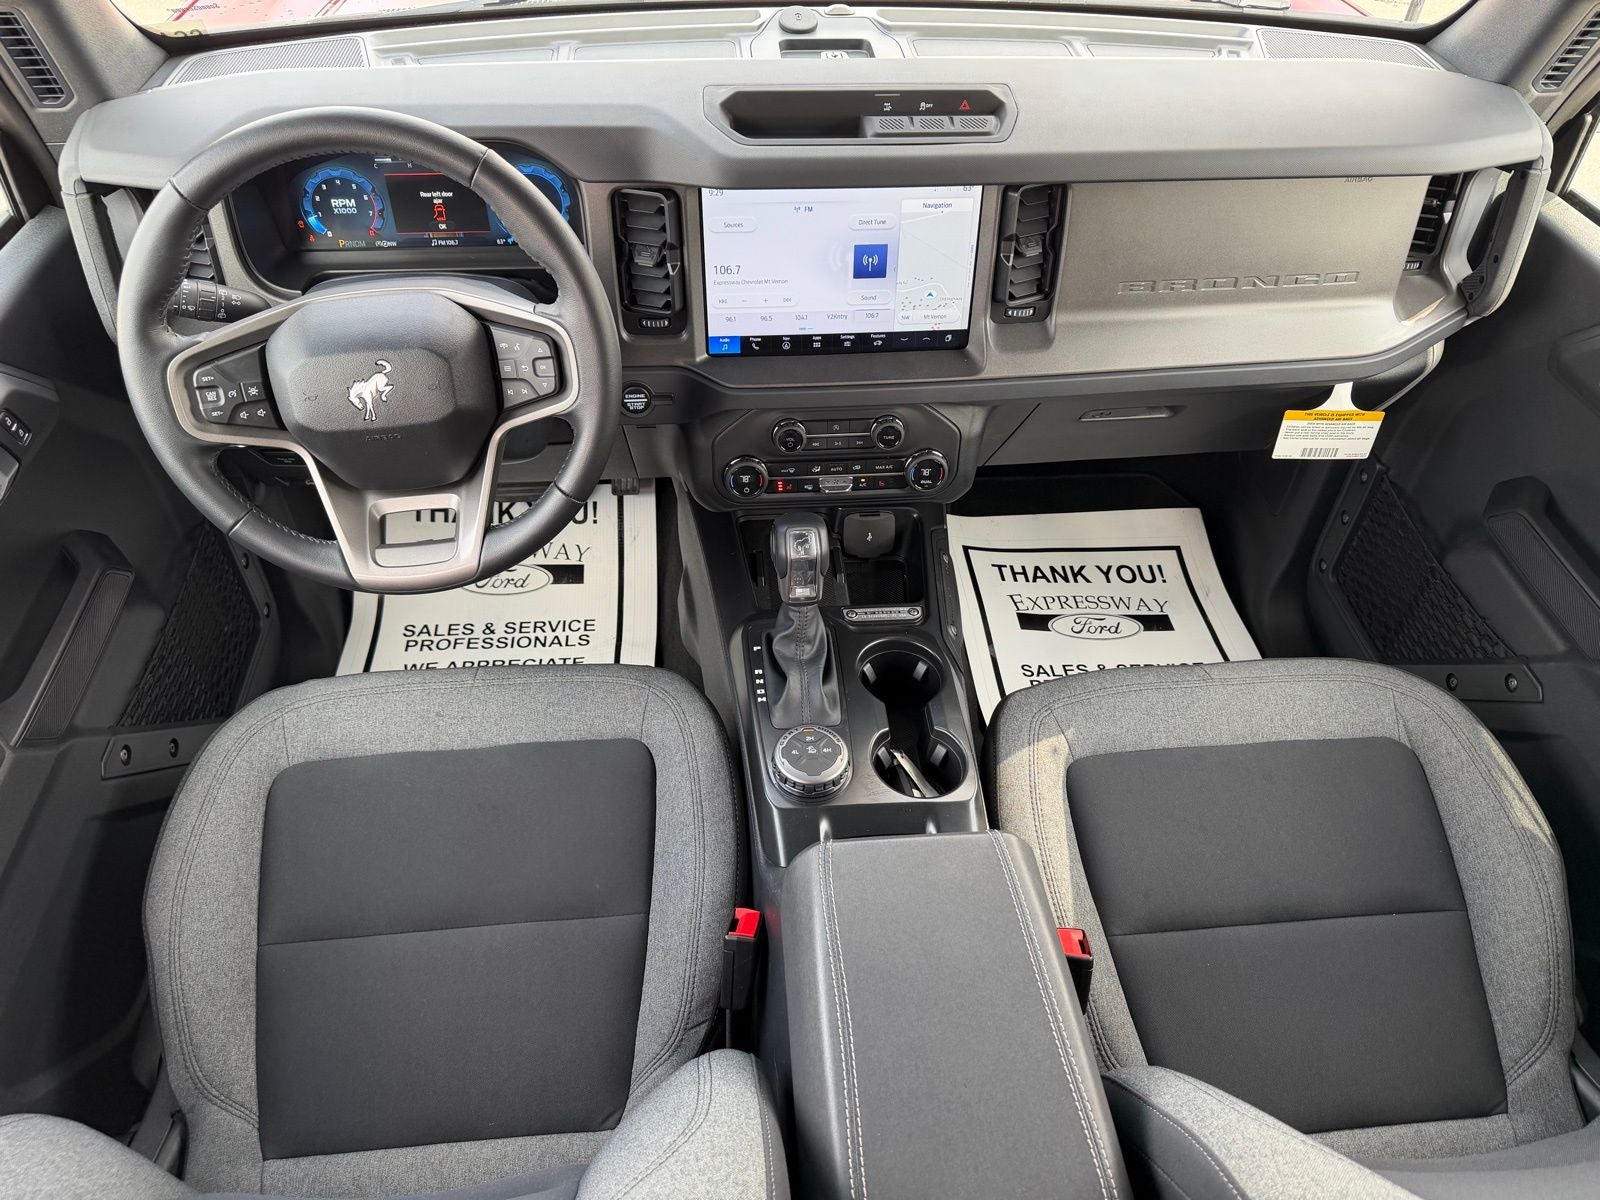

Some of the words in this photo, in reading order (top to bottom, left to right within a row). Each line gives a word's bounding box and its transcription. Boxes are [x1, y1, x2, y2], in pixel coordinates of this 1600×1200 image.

[330, 198, 357, 208] RPM
[922, 202, 953, 210] Navigation
[874, 218, 887, 226] Tune
[713, 264, 741, 276] 106.7
[1117, 270, 1360, 295] BRONCO
[991, 563, 1093, 585] THANK
[1095, 564, 1167, 584] YOU!
[402, 623, 474, 638] SALES
[482, 621, 497, 635] &
[503, 619, 596, 635] SERVICE
[1070, 615, 1123, 636] Ford
[404, 634, 591, 652] PROFESSIONALS
